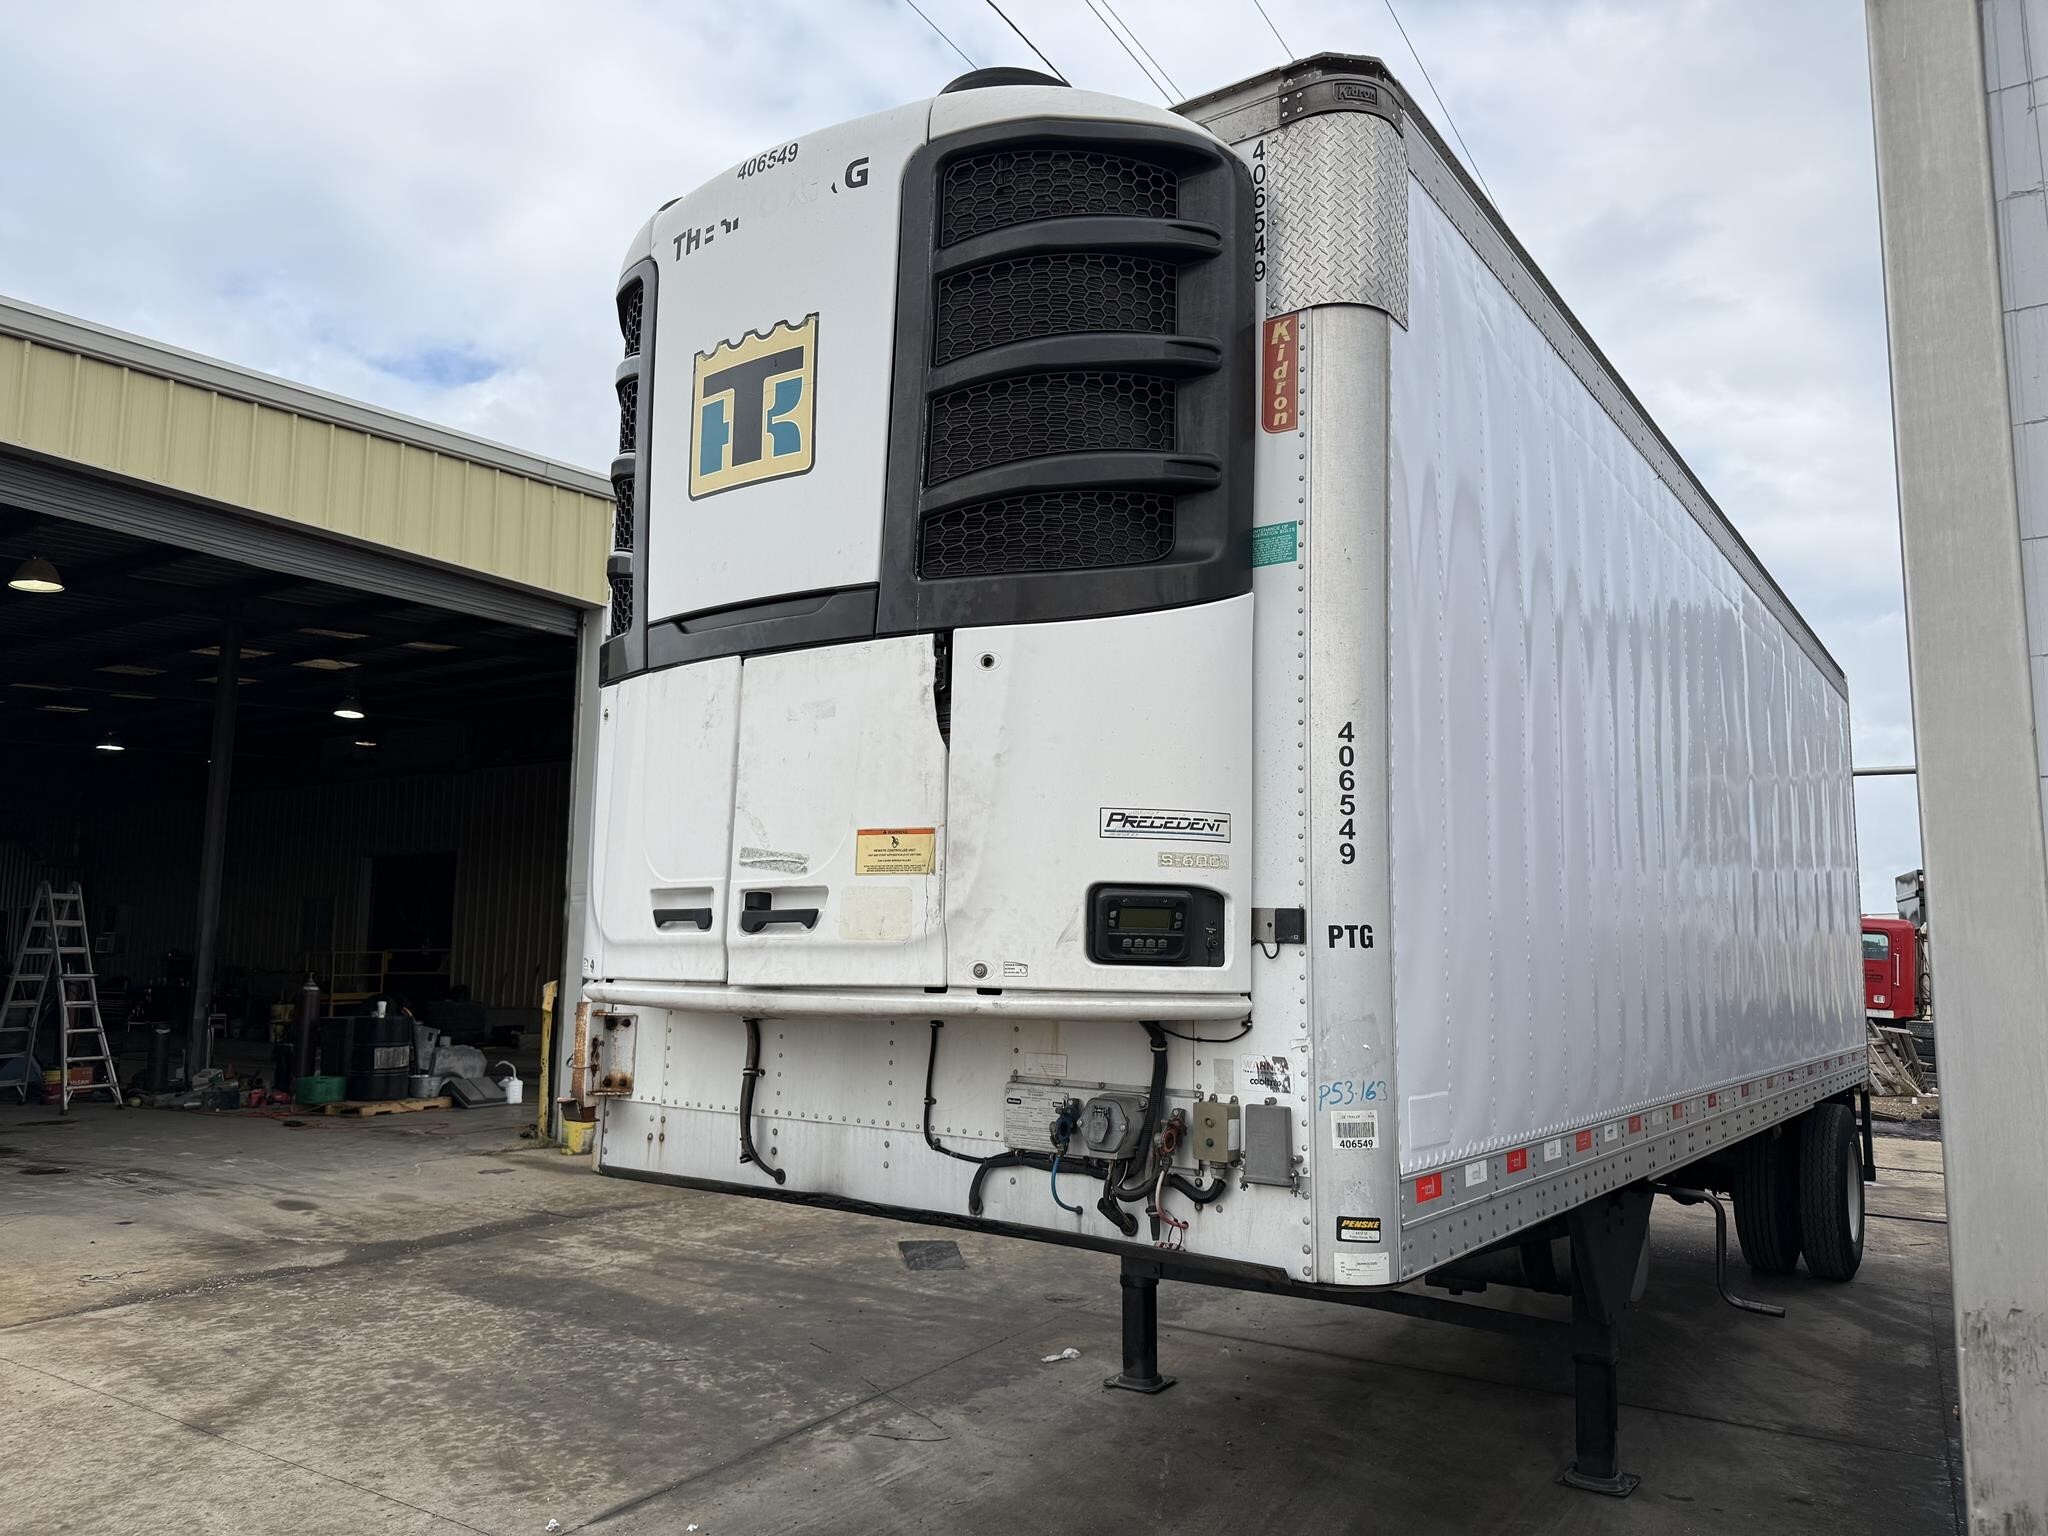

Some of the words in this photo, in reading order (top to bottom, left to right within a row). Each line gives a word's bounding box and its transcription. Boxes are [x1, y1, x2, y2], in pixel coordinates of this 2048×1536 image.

[1337, 84, 1377, 101] Kidron
[737, 142, 799, 180] 406549
[1271, 319, 1292, 427] Kidron
[1337, 721, 1356, 865] 406549
[1106, 811, 1228, 832] PRECEDENT
[1328, 924, 1374, 949] PTG
[1339, 1139, 1374, 1149] 406549
[1341, 1220, 1380, 1228] PENSKE
